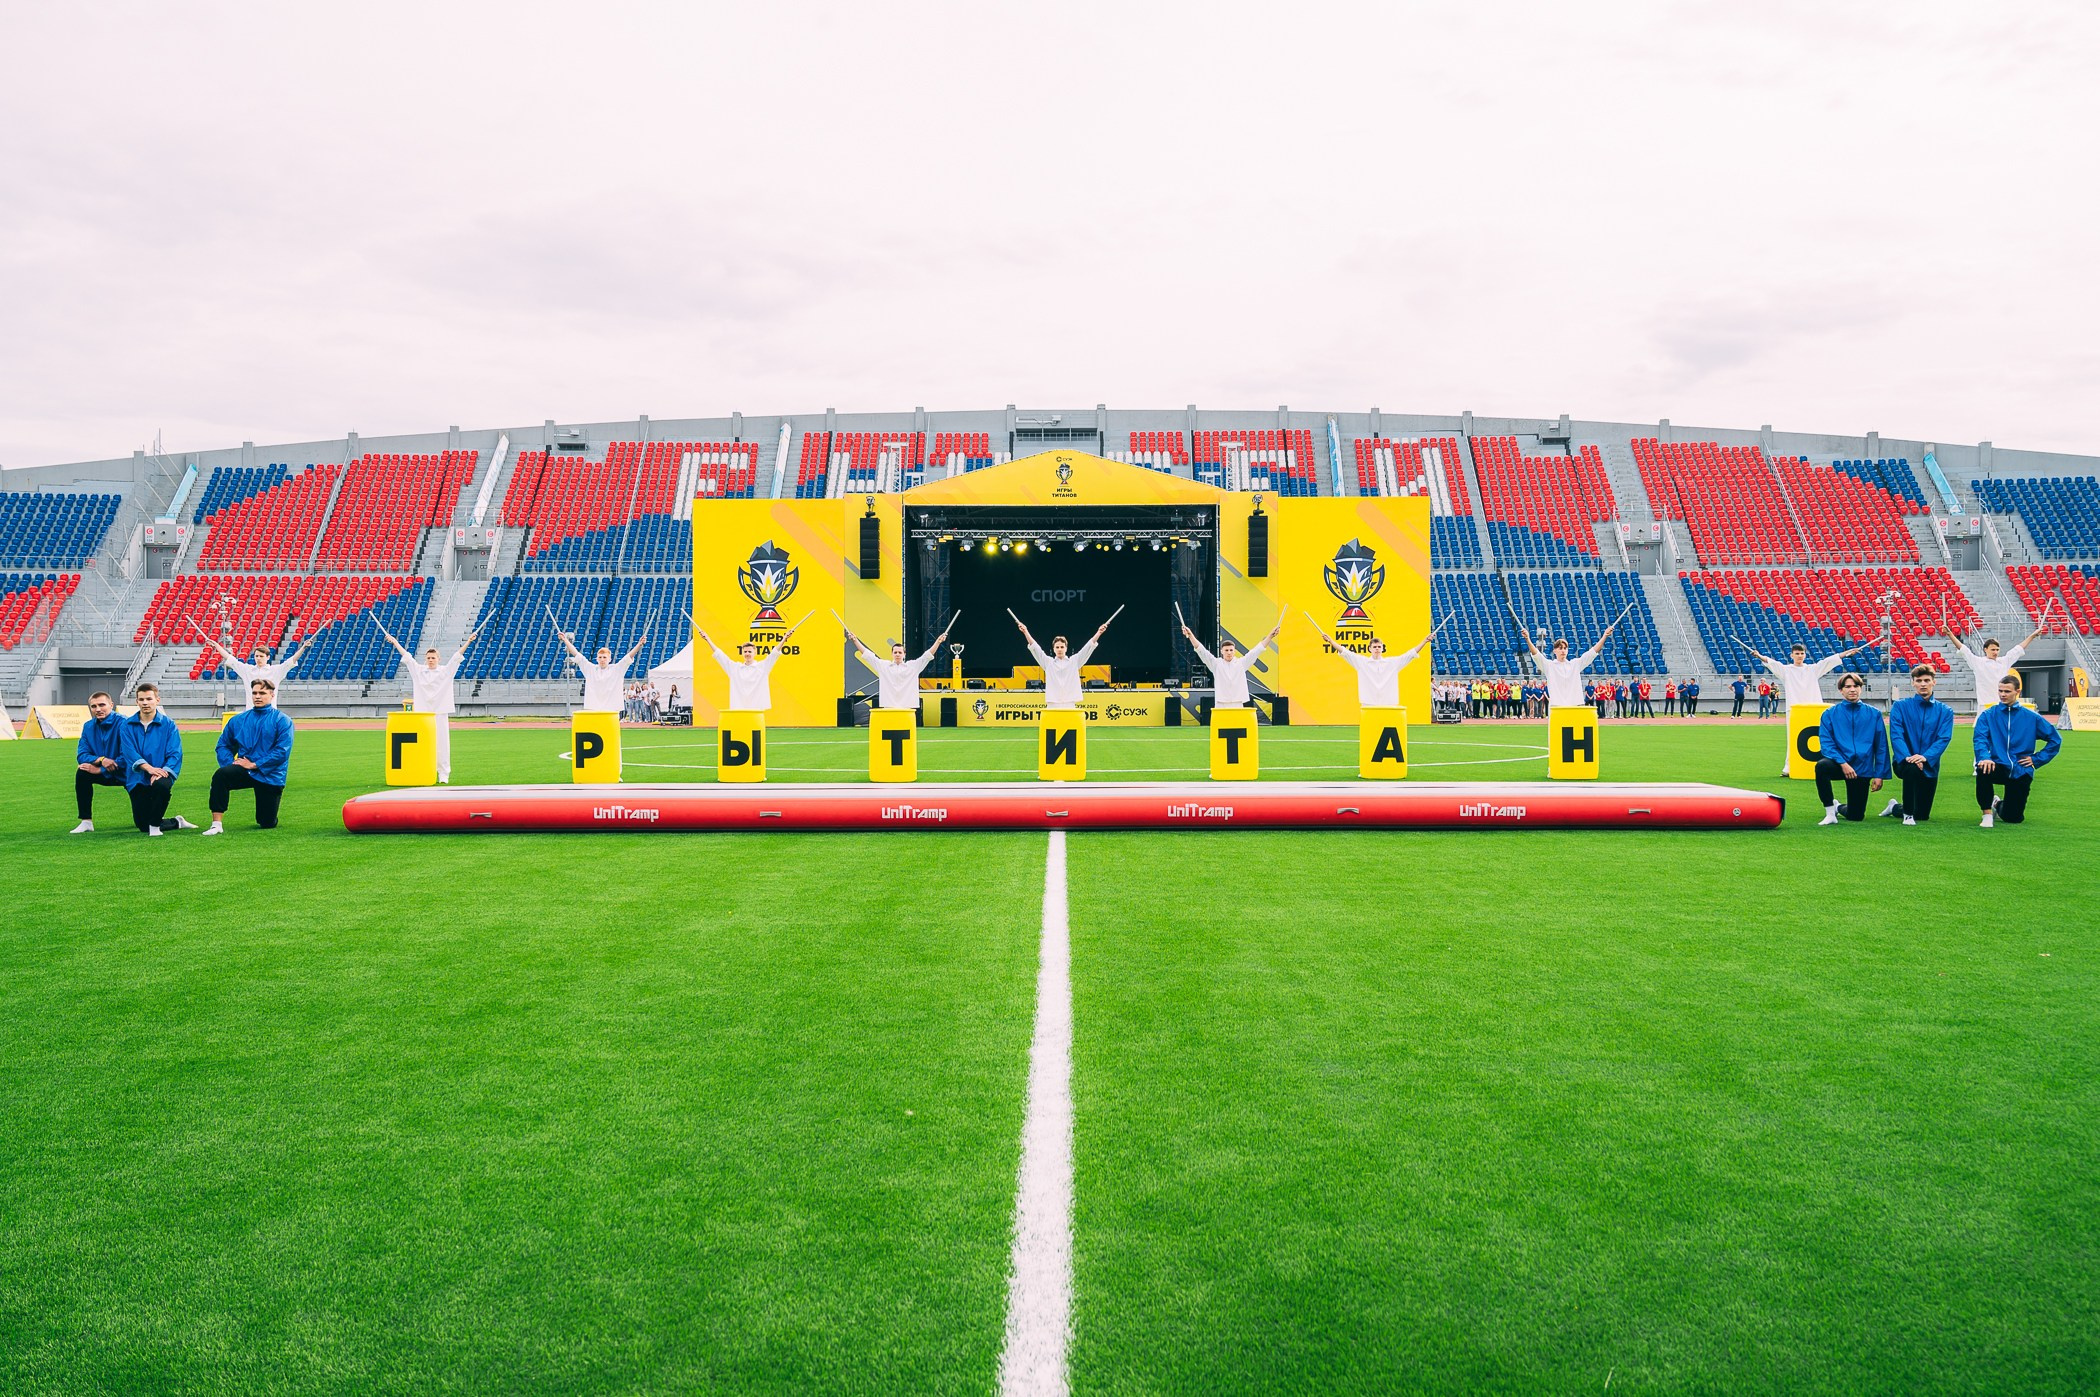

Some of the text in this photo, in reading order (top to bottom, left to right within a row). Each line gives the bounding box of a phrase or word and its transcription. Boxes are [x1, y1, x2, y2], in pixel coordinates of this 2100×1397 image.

[1031, 589, 1087, 602] СПОРТ
[749, 632, 788, 642] ИГРЫ
[1335, 631, 1374, 640] ИГРЫ
[736, 645, 800, 655] ТТАОВ
[995, 711, 1034, 720] ИГРЫ
[1123, 708, 1148, 716] СУЭК
